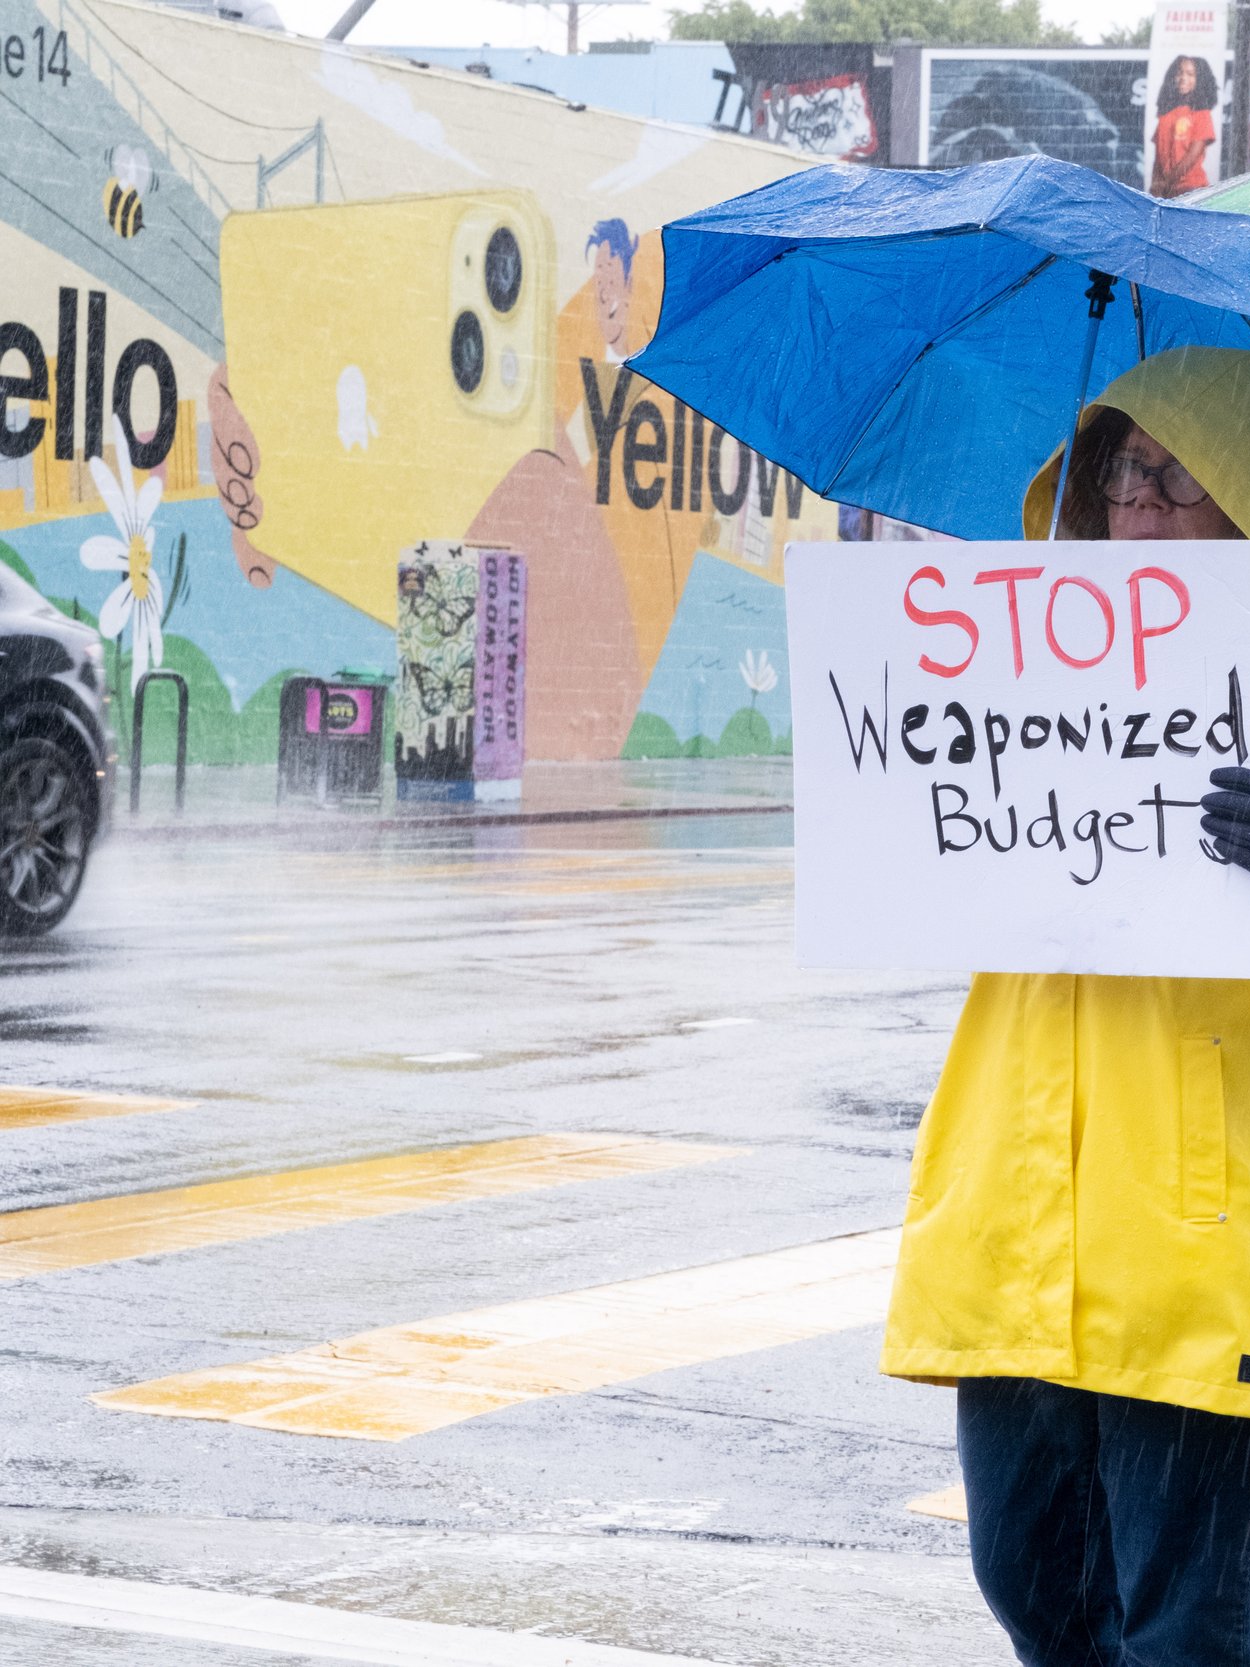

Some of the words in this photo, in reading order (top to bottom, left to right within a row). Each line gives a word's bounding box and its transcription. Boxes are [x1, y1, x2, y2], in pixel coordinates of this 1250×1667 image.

[33, 26, 71, 87] 14
[1166, 10, 1215, 22] FAIRFAX
[578, 357, 803, 520] Yellow
[903, 565, 1191, 691] STOP
[829, 660, 1249, 801] Weaponized
[931, 782, 1201, 886] Budget
